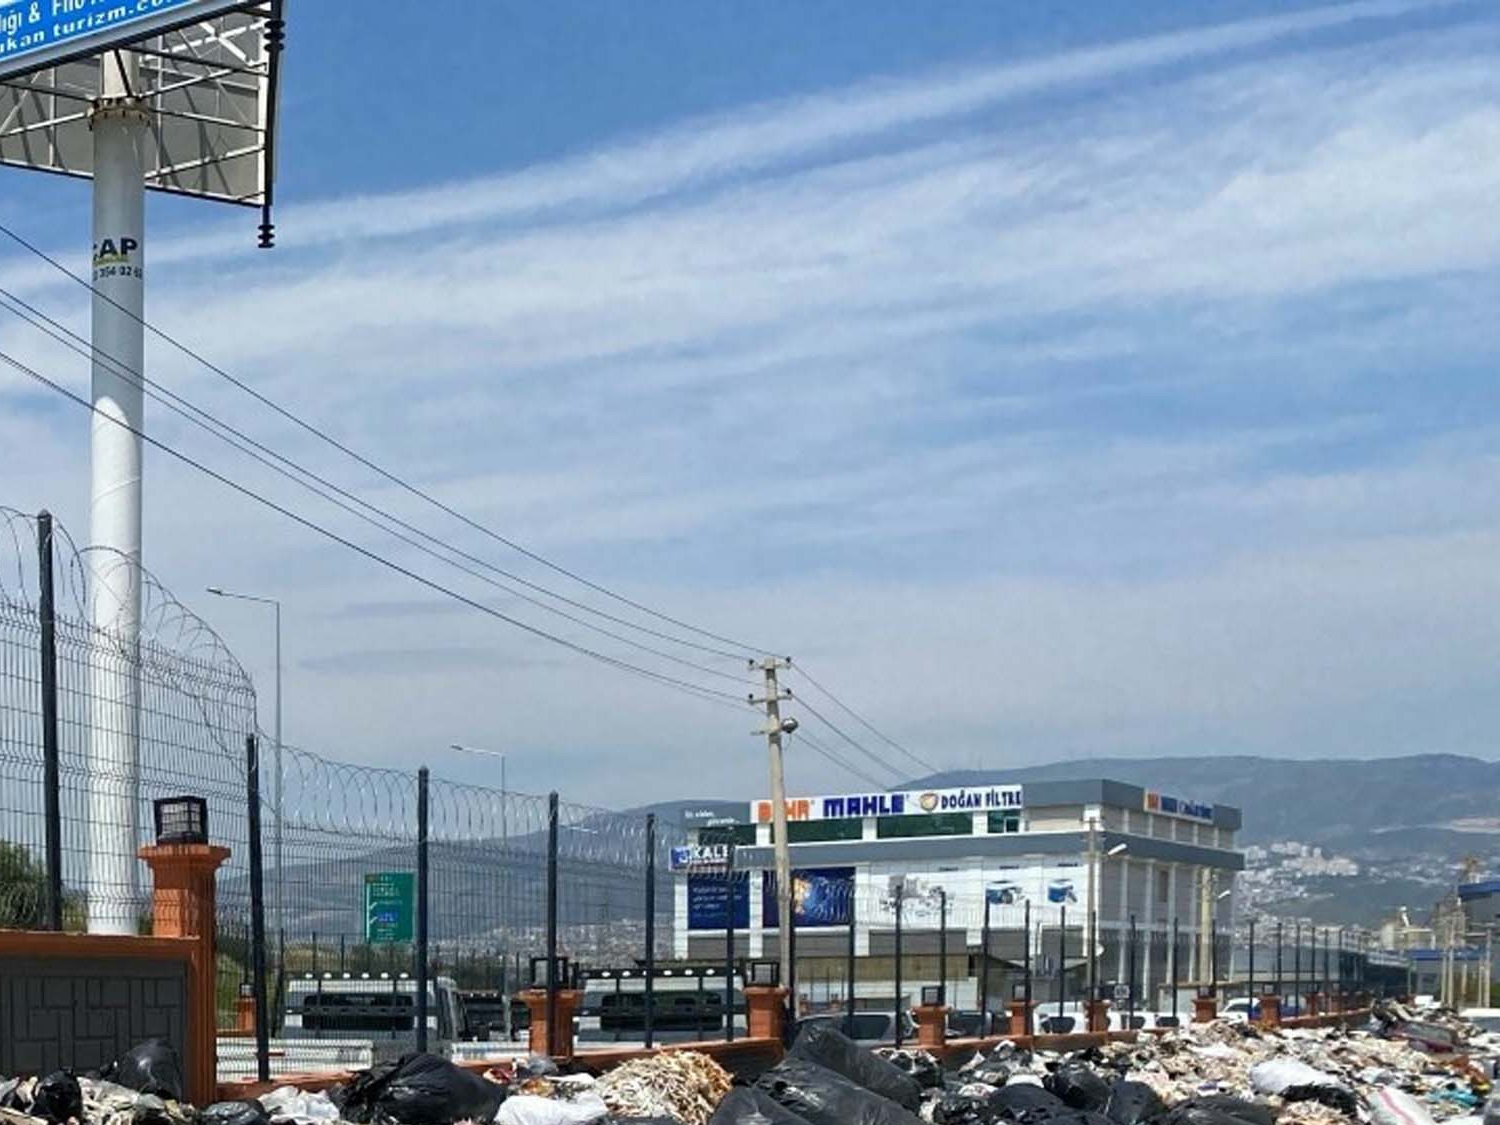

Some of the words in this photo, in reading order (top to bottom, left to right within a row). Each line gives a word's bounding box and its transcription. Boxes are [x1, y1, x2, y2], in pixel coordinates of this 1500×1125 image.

[28, 1, 41, 24] &
[53, 0, 172, 38] turizm.co
[758, 799, 810, 822] BHR
[823, 794, 905, 817] MAHLE
[941, 789, 982, 810] DOĞAN
